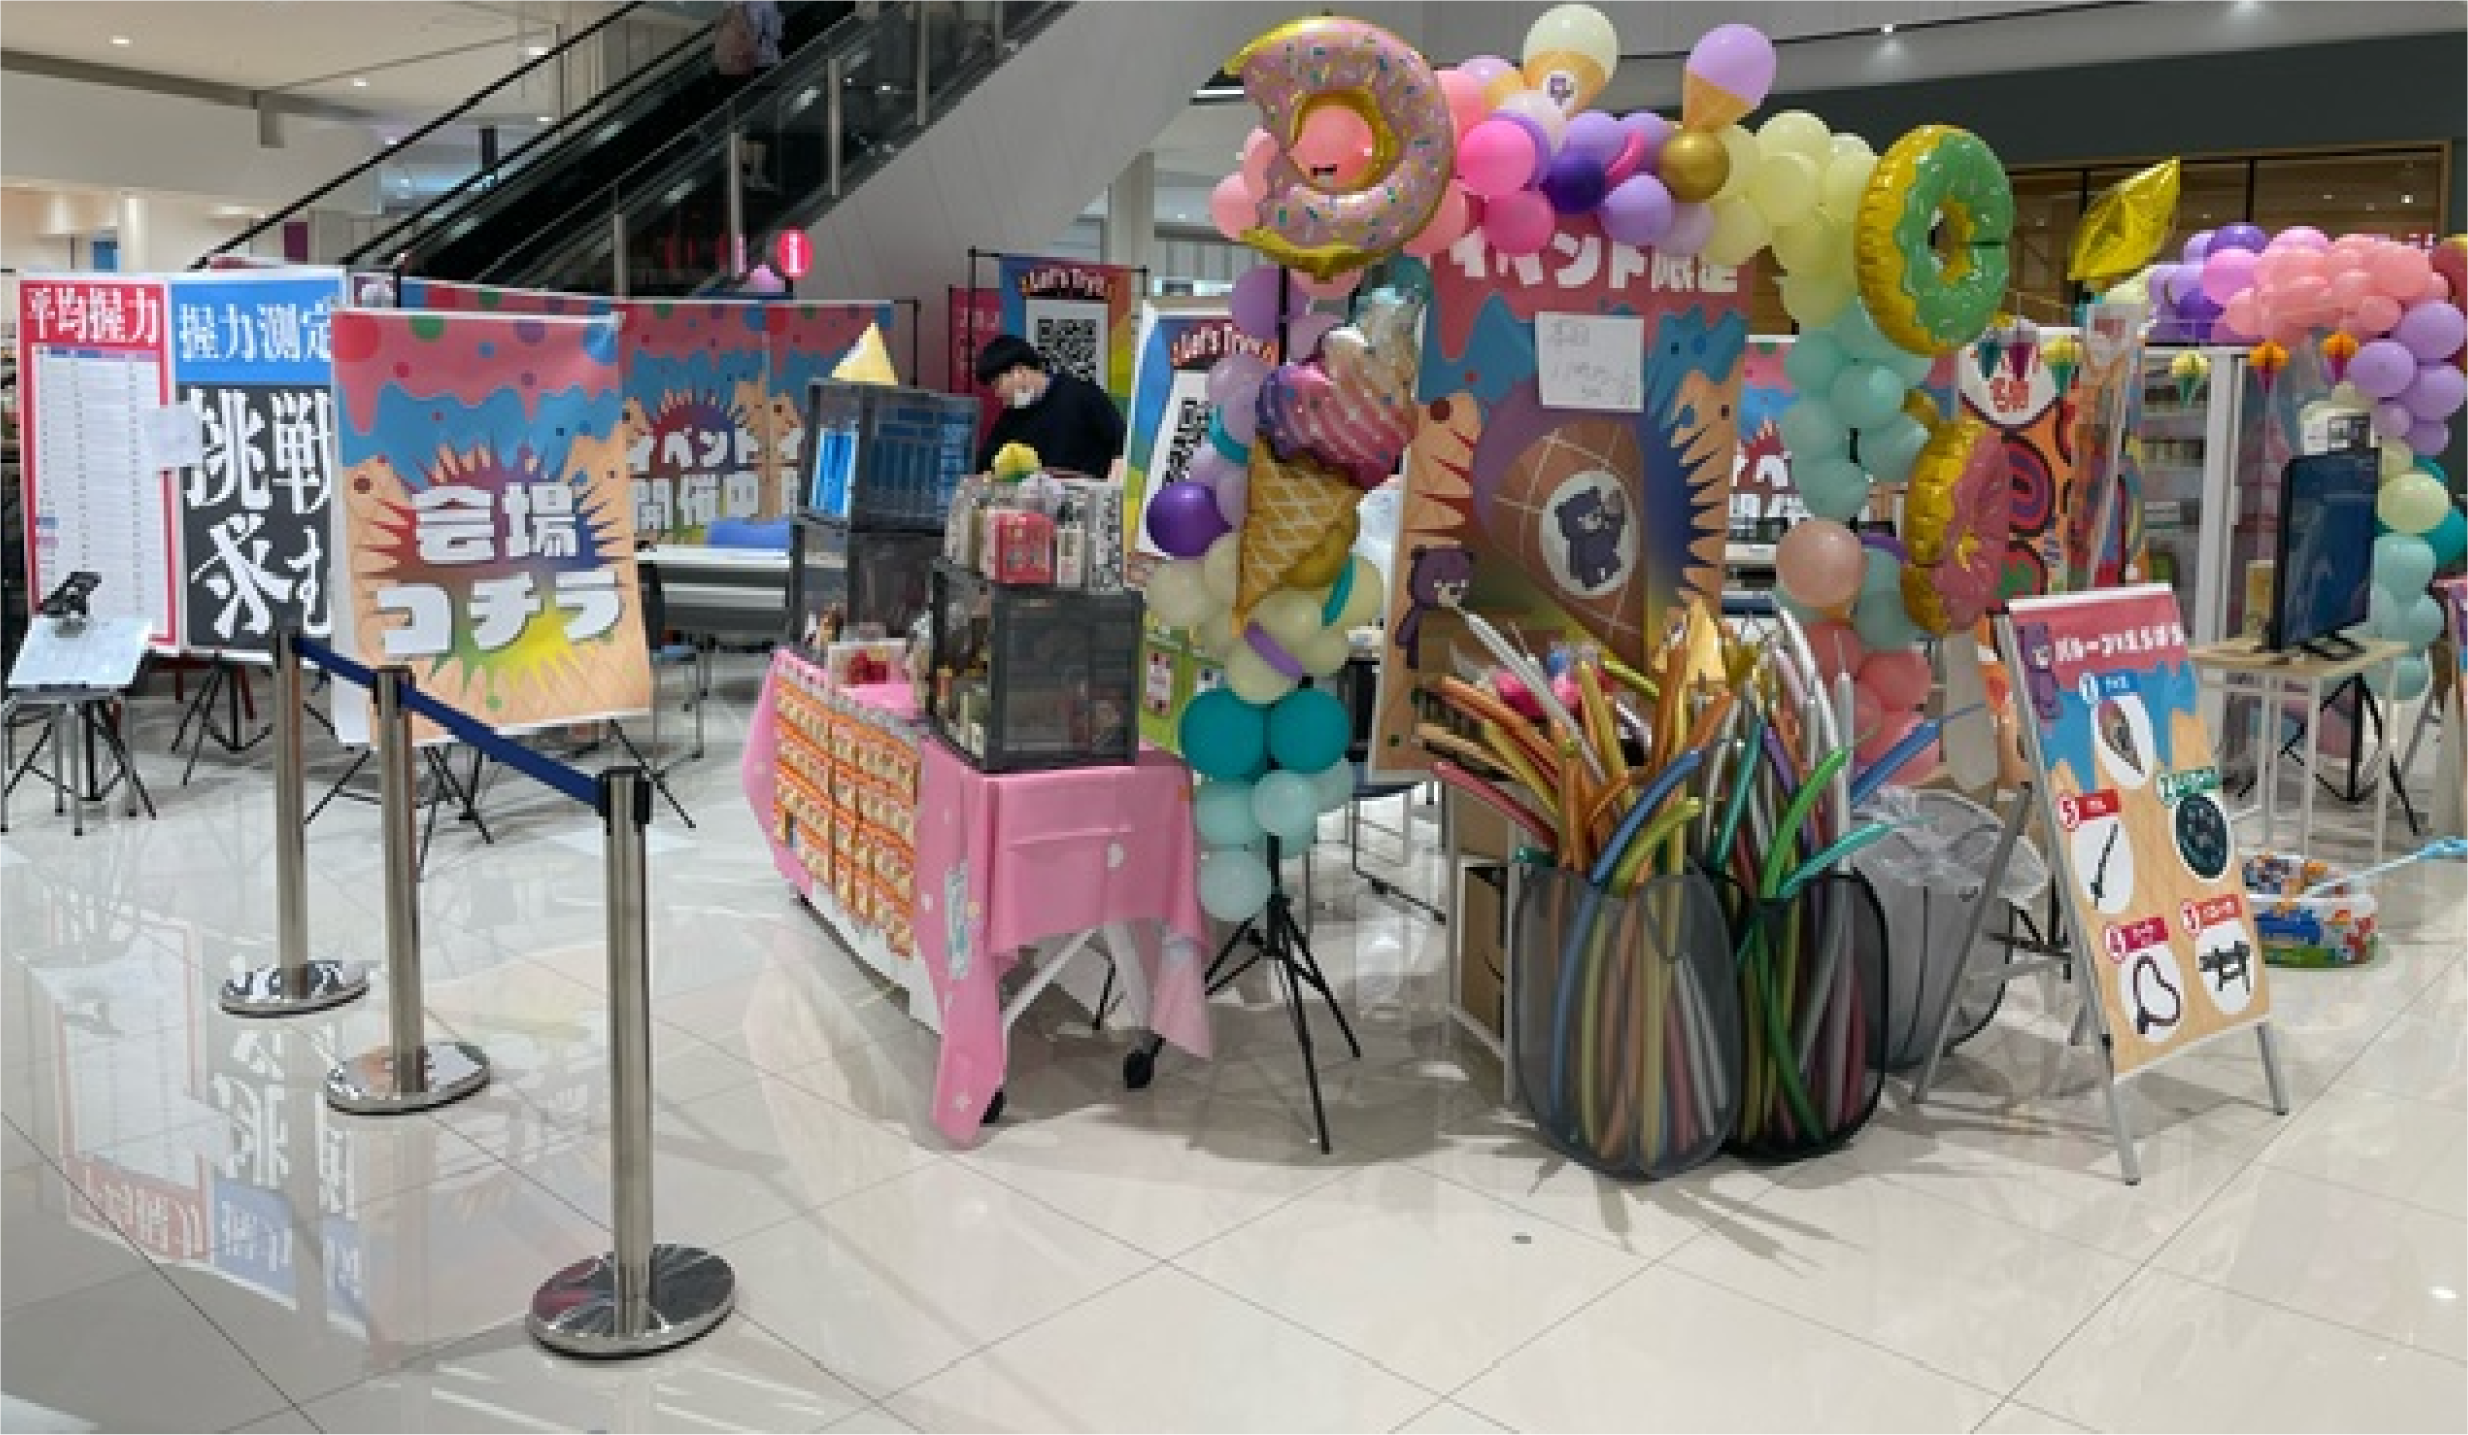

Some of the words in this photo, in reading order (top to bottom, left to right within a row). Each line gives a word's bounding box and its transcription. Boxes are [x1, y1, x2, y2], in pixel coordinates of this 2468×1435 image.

[27, 287, 161, 343] 平均握力
[179, 301, 331, 363] 握力測定
[414, 481, 580, 565] 会場
[376, 568, 622, 656] コチラ
